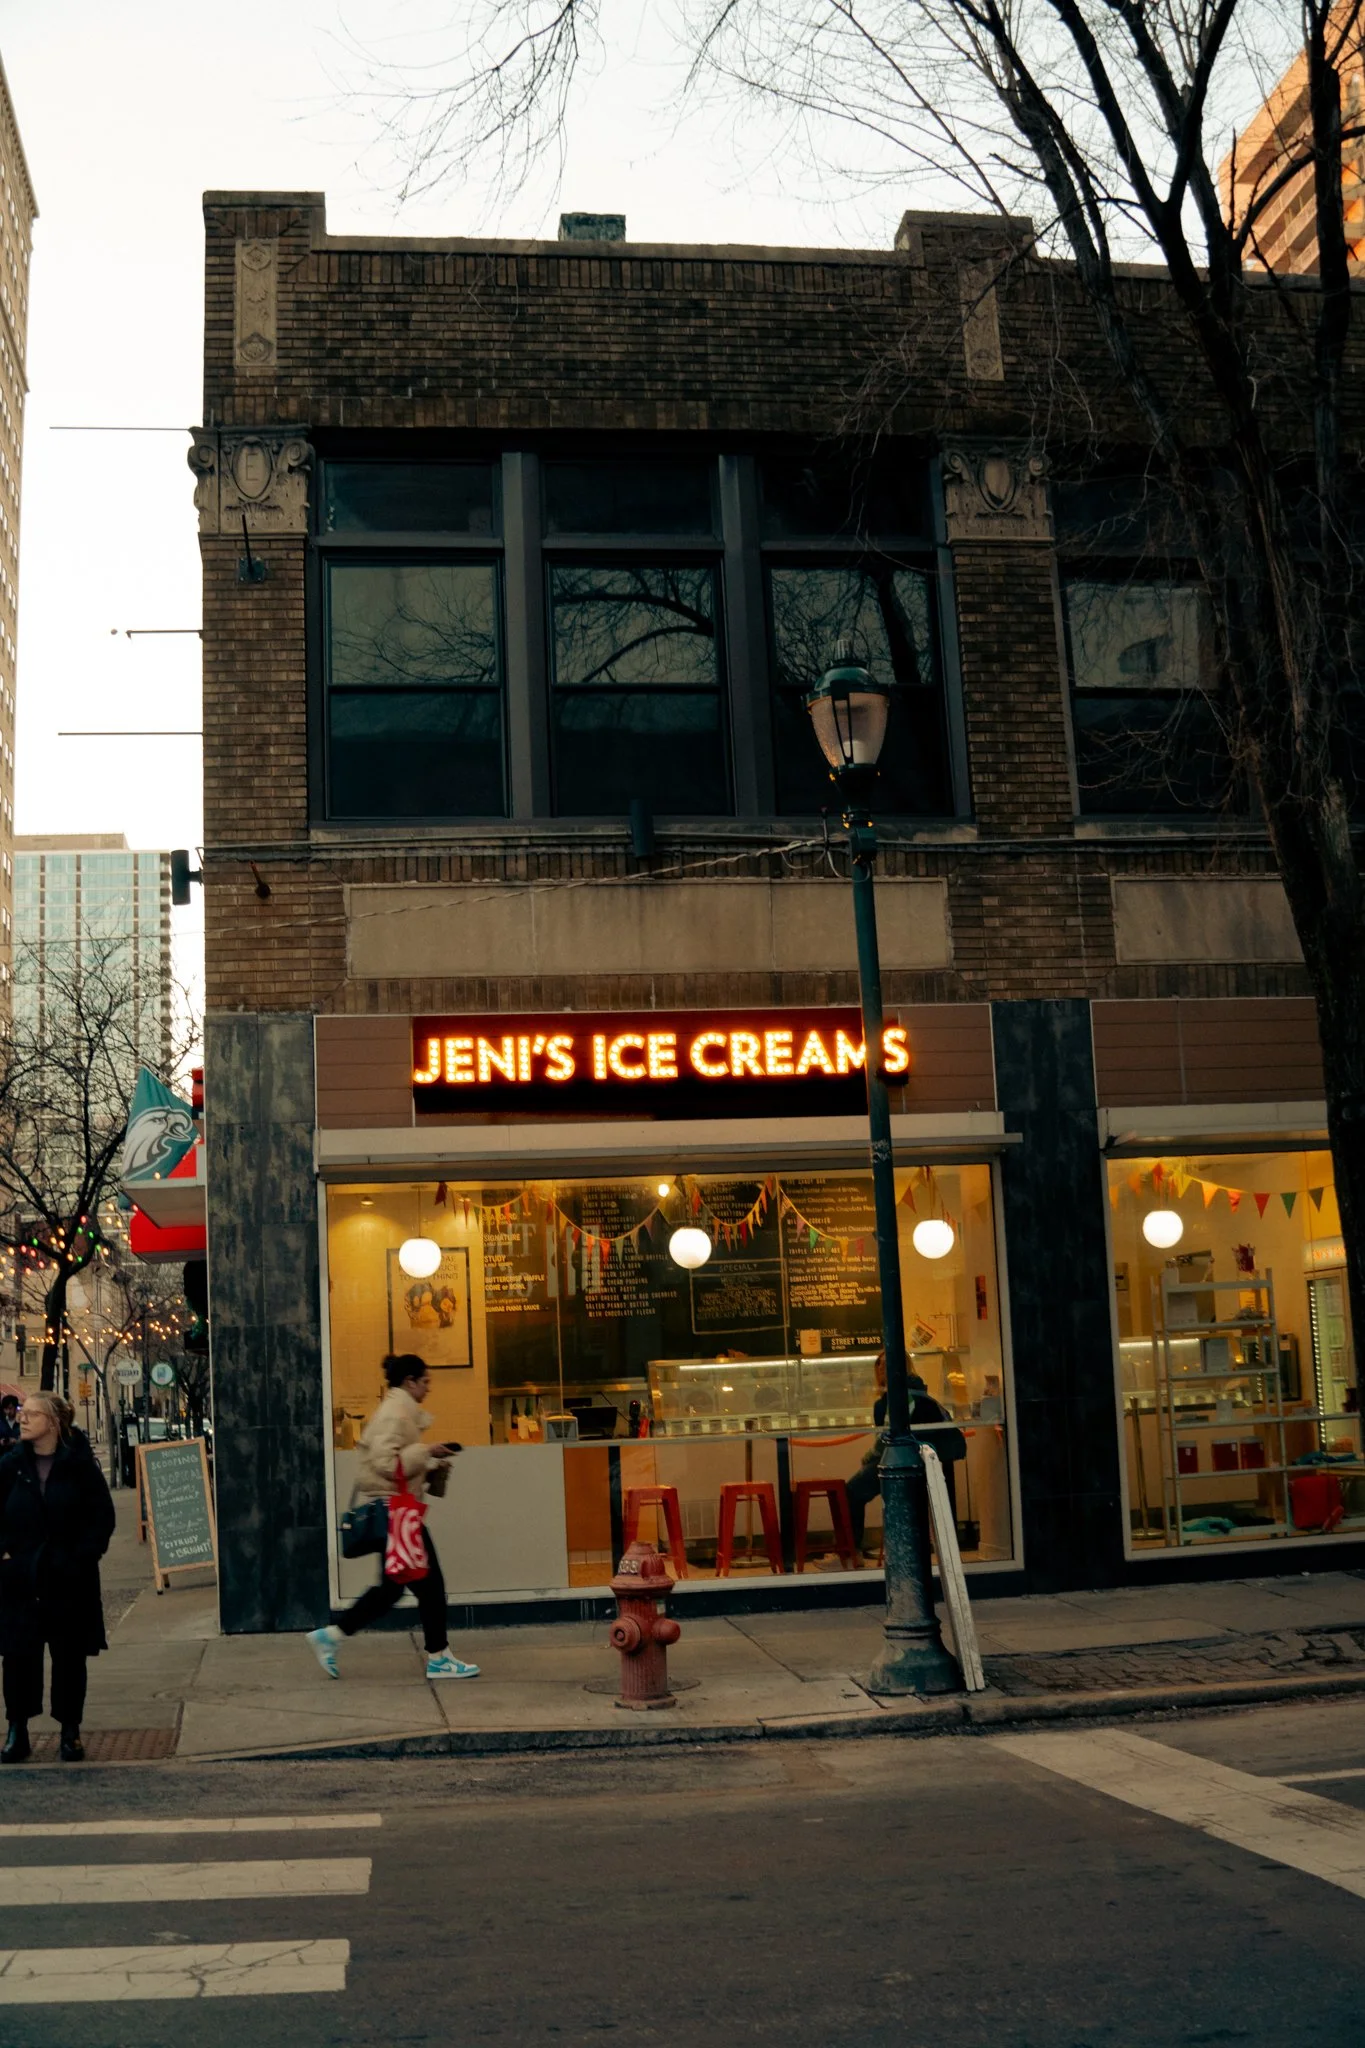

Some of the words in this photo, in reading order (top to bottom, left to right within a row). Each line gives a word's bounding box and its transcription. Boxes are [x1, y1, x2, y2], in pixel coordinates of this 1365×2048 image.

[413, 1034, 576, 1084] JENI'S
[592, 1032, 678, 1080] ICE
[690, 1027, 908, 1077] CREAMS
[831, 1337, 855, 1346] STREET
[856, 1336, 881, 1344] TREATS
[151, 1454, 199, 1470] SCOOPING
[151, 1468, 203, 1488] TROPICAL
